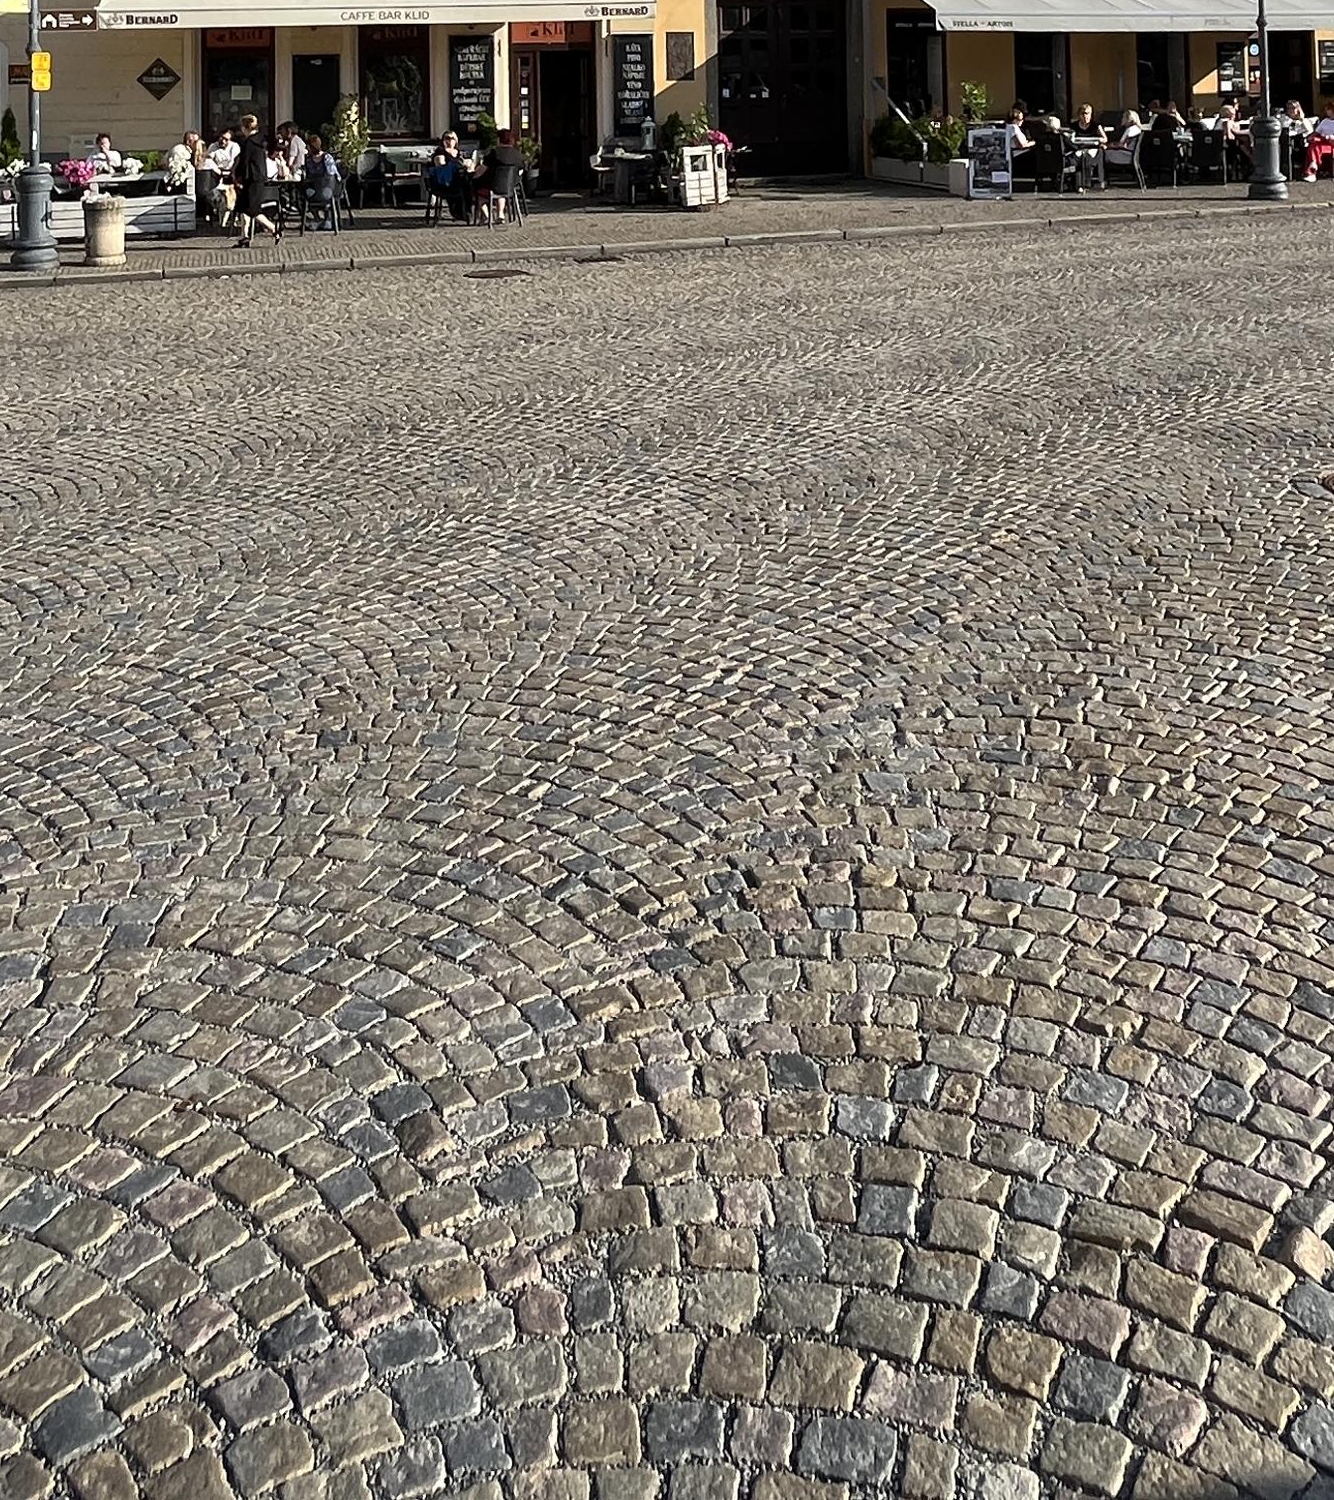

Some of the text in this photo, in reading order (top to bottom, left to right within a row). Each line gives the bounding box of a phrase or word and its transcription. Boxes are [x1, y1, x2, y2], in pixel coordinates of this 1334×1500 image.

[340, 10, 430, 21] CAFFE BAR KLID
[601, 6, 649, 17] BERNARD
[125, 14, 179, 25] BERNARD
[952, 20, 1013, 28] STELLA ARTOIS
